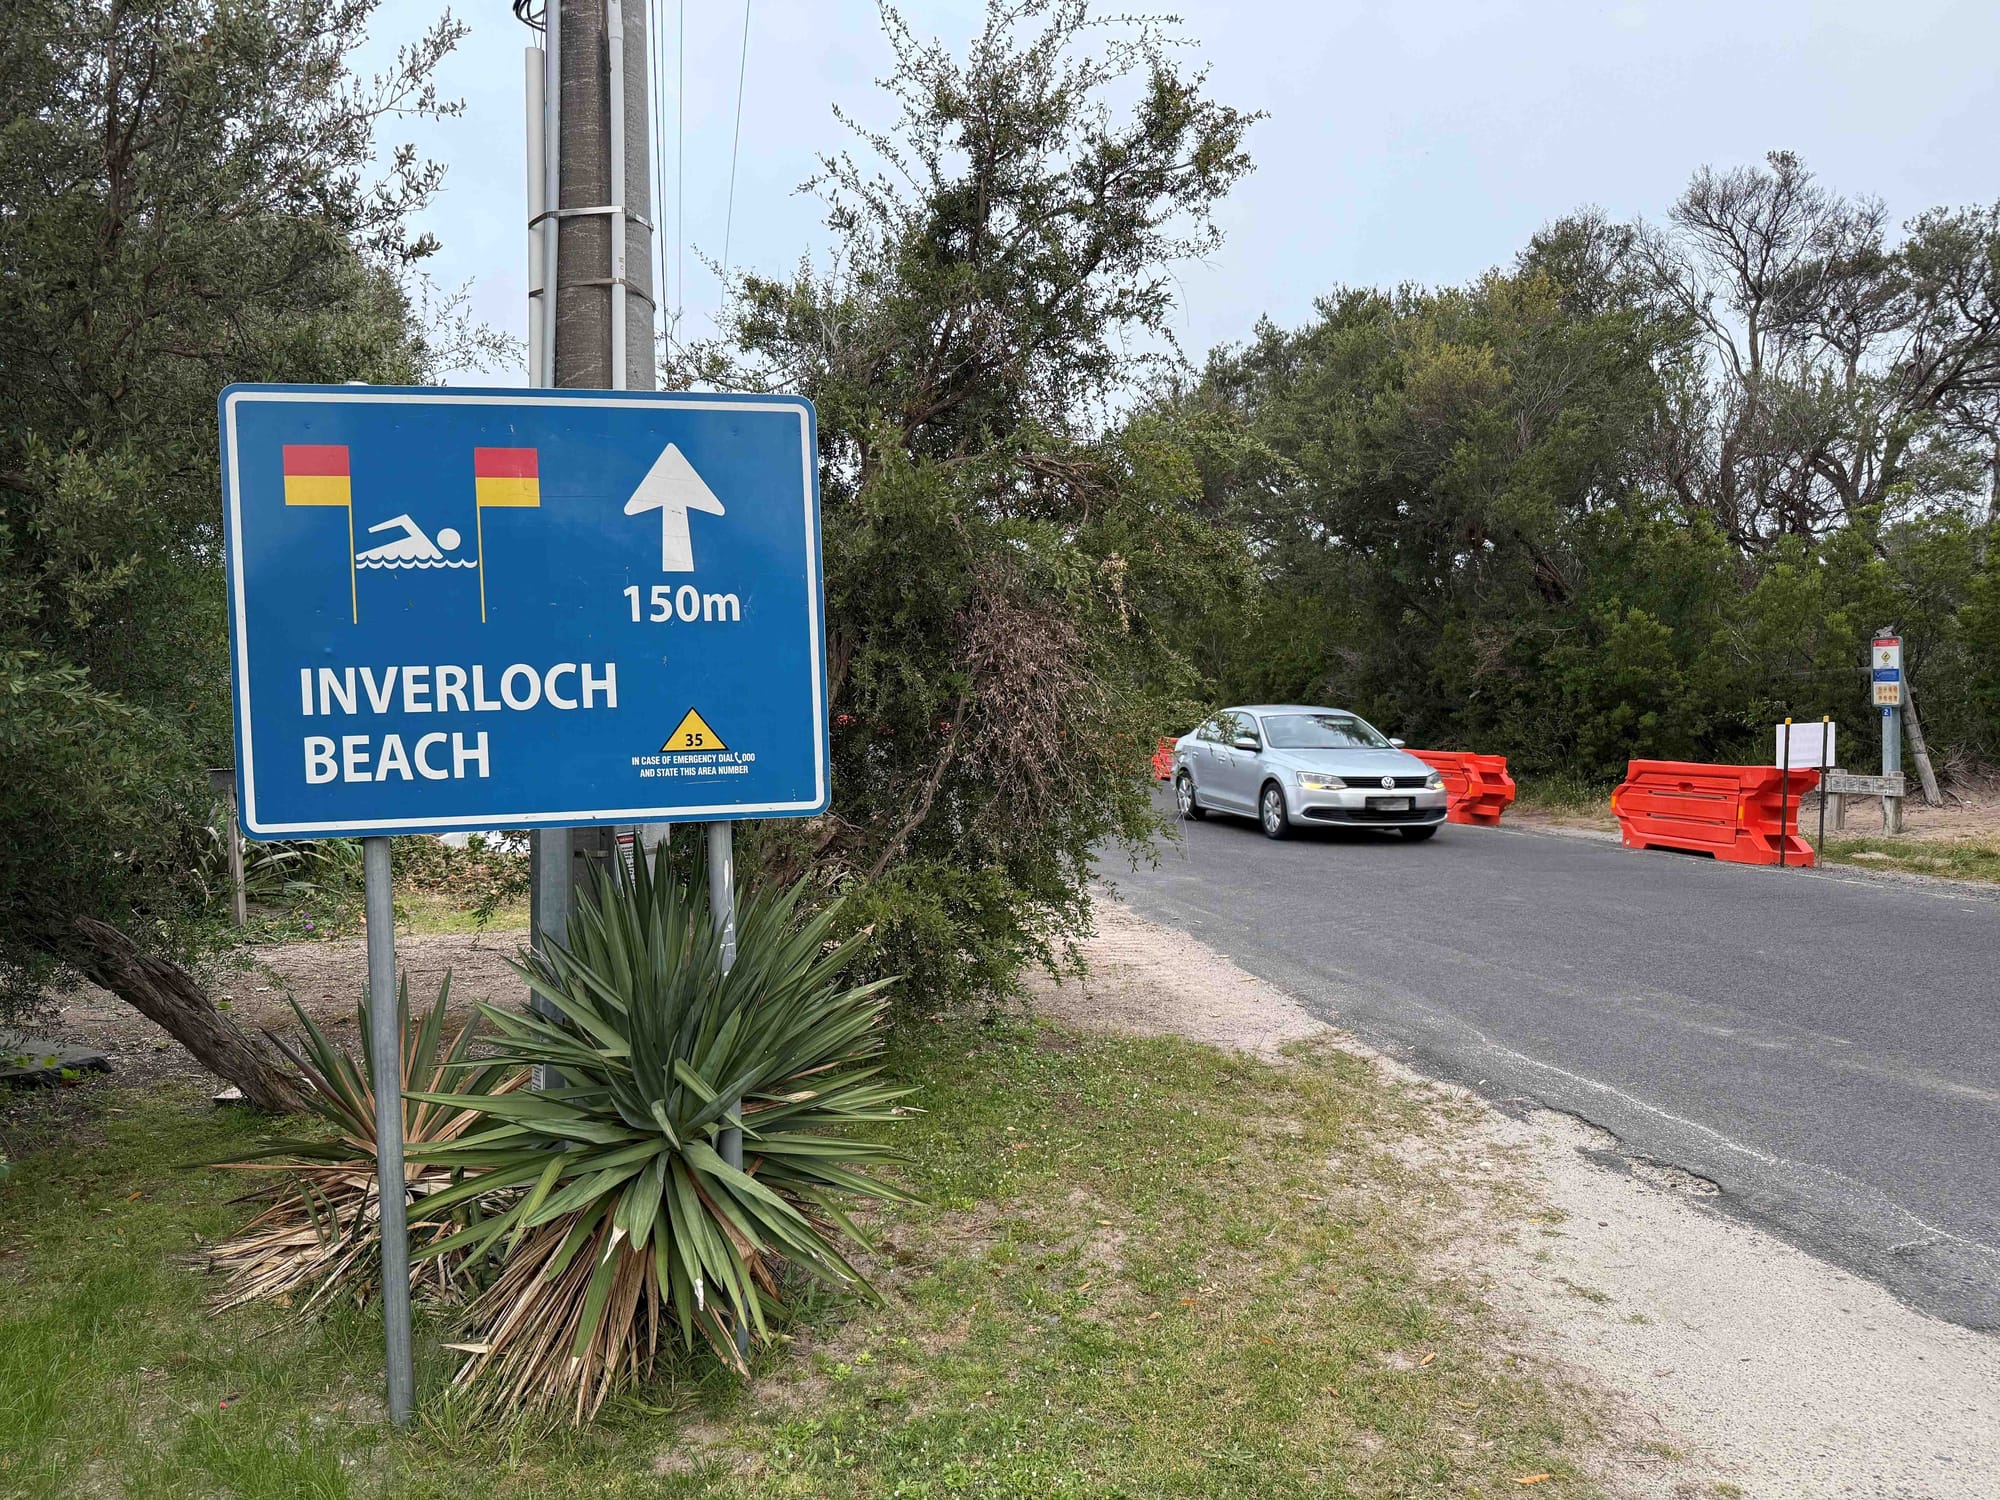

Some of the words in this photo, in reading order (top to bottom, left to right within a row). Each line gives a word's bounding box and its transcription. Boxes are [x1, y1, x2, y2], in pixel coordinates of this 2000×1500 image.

[623, 585, 741, 623] 150m
[300, 662, 618, 716] INVERLOCH
[685, 733, 703, 747] 35
[303, 731, 490, 784] BEACH
[631, 756, 640, 766] IN
[641, 755, 661, 766] CASE
[661, 755, 672, 765] OF
[673, 753, 717, 765] EMERGENCY
[718, 753, 735, 763] DIAL
[741, 752, 756, 762] 000
[639, 768, 655, 778] AND
[656, 767, 679, 777] STATE
[680, 766, 697, 776] THIS
[697, 765, 717, 776] AREA
[718, 765, 749, 775] NUMBER
